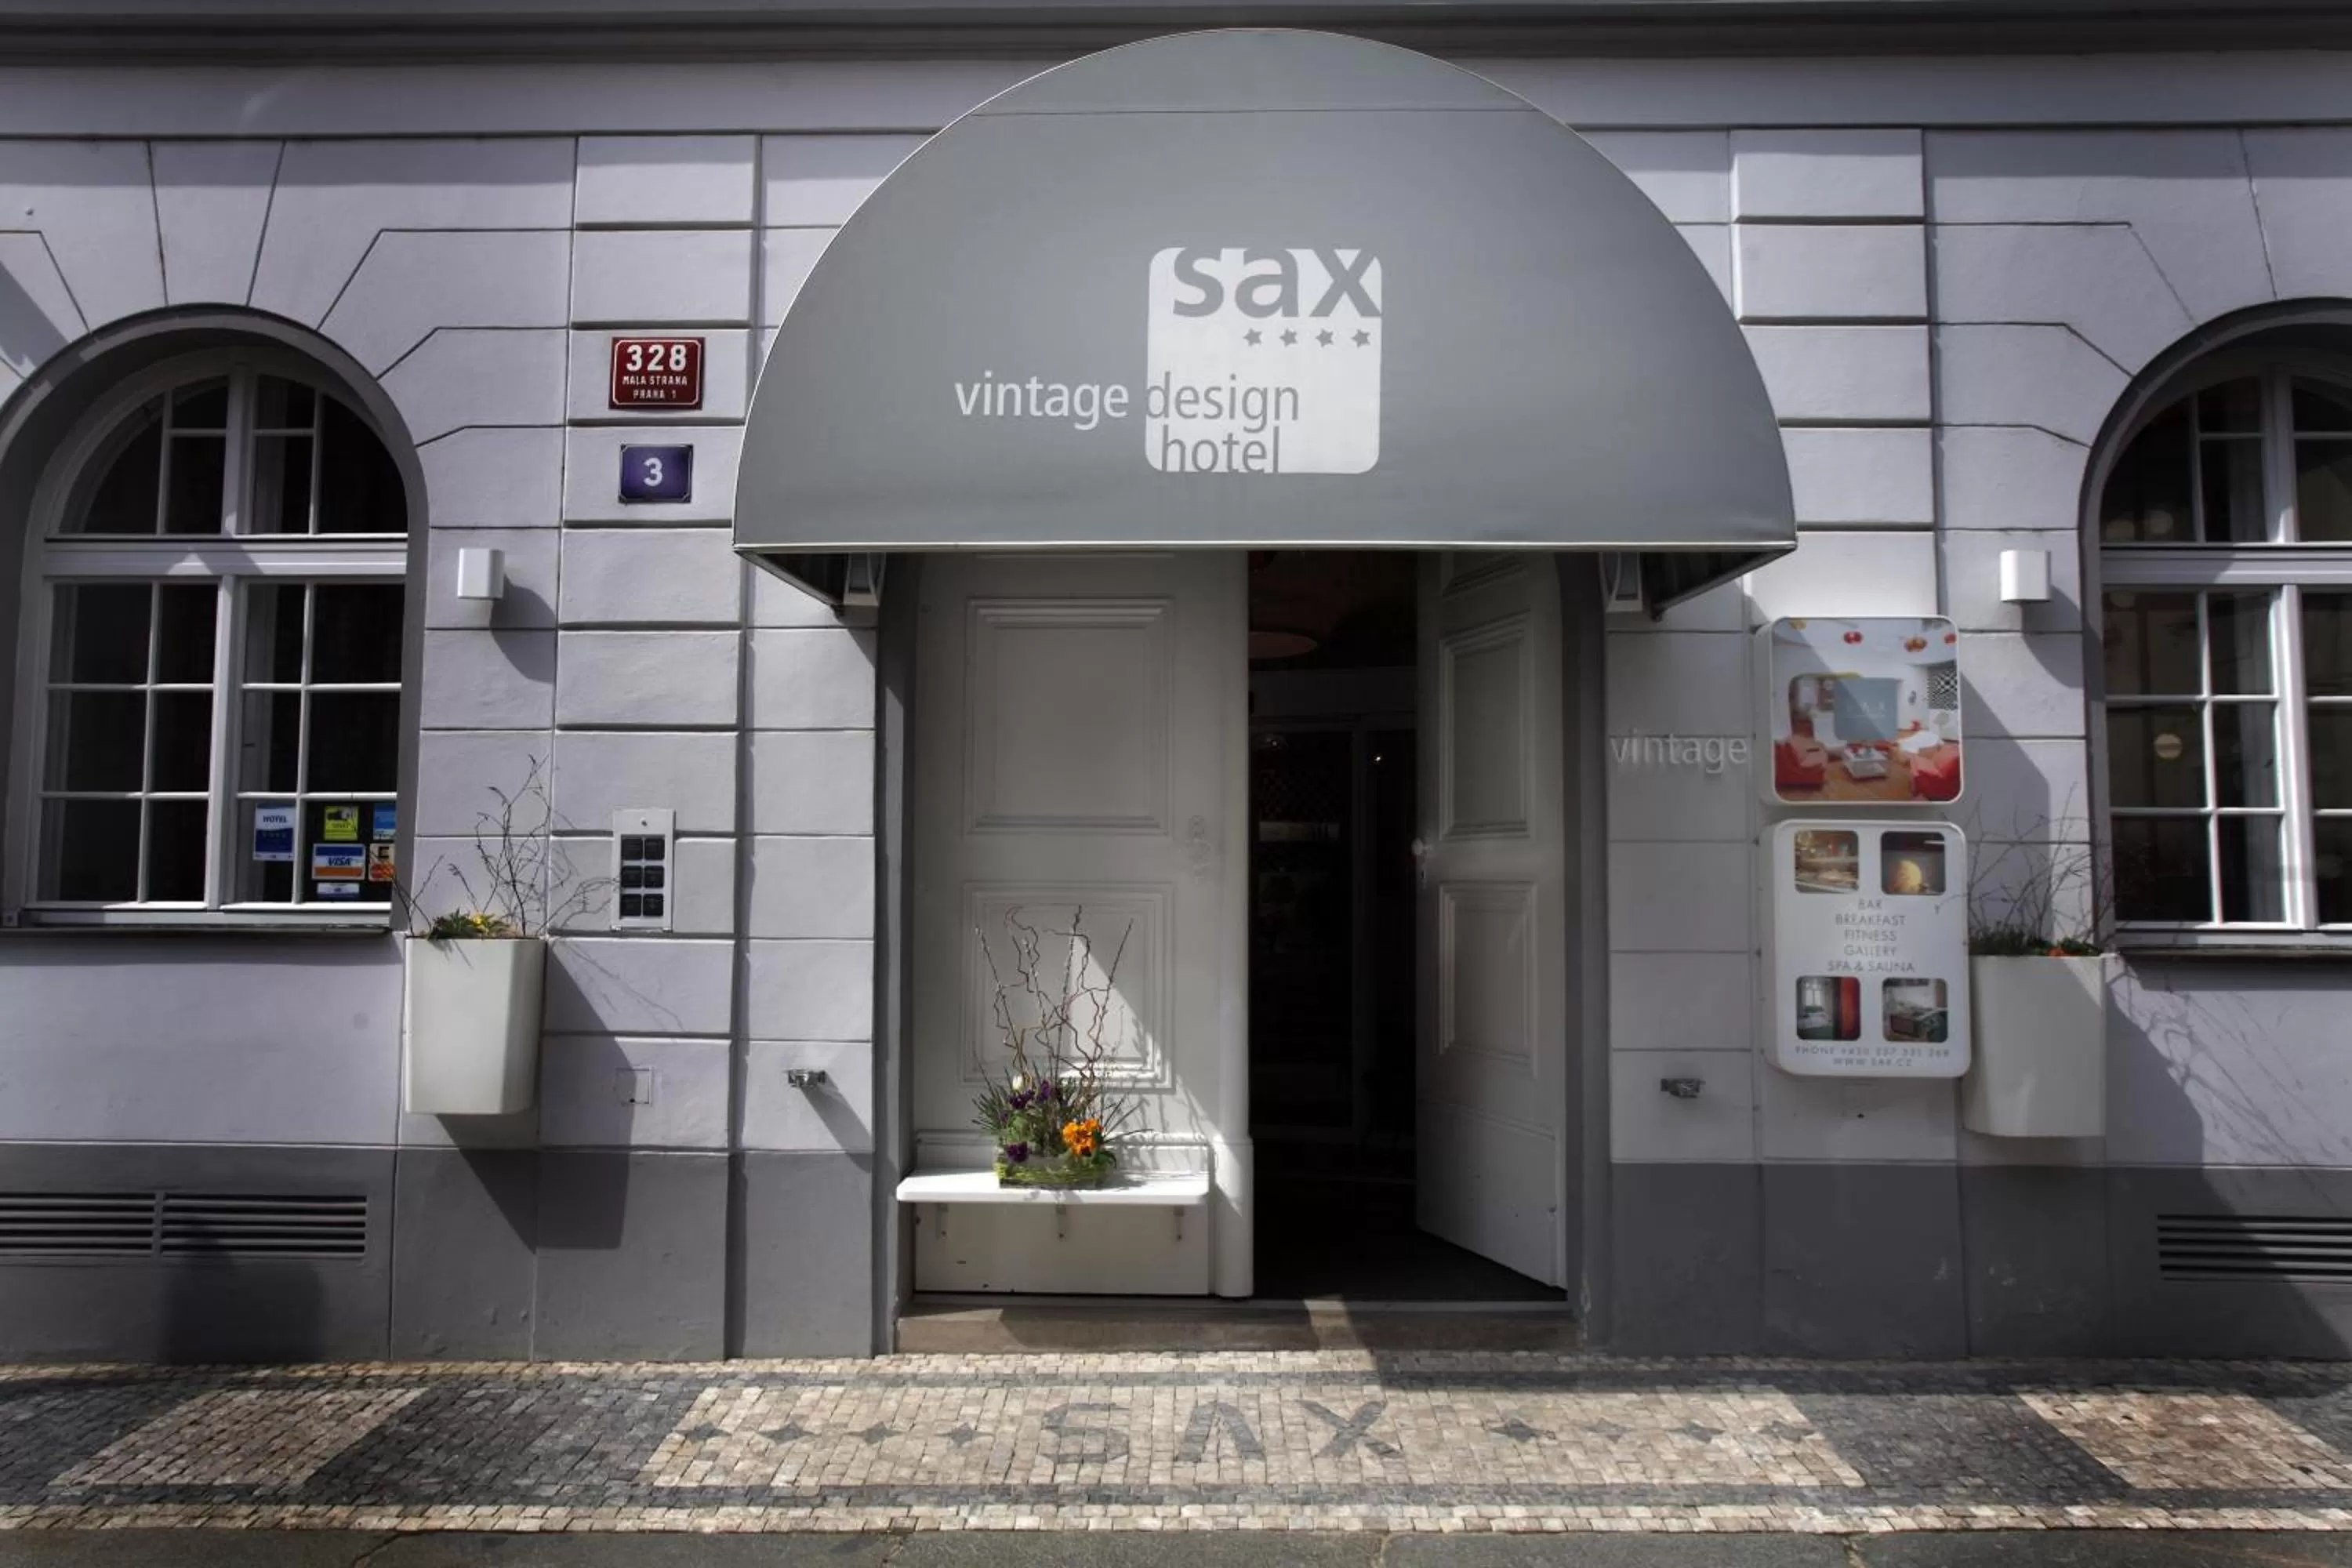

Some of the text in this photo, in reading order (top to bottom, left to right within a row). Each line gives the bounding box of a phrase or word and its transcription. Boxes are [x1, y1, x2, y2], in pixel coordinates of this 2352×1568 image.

[1172, 245, 1382, 318] sax
[626, 344, 687, 372] 328
[649, 375, 688, 386] STRANA
[633, 388, 677, 399] PRAHA 1
[954, 370, 1300, 434] vintage design
[1161, 424, 1279, 473] hotel
[643, 457, 663, 487] 3
[1608, 728, 1748, 773] vintage
[263, 815, 287, 823] HOTEL
[328, 856, 353, 866] VISA
[1858, 898, 1882, 910] BAR
[1835, 913, 1906, 926] BREAKFAST
[1844, 928, 1898, 942] FITNESS
[1828, 959, 1915, 972] SPA & SAUNA
[1795, 1045, 1835, 1055] PHONE
[1039, 1399, 1406, 1464] SAX
